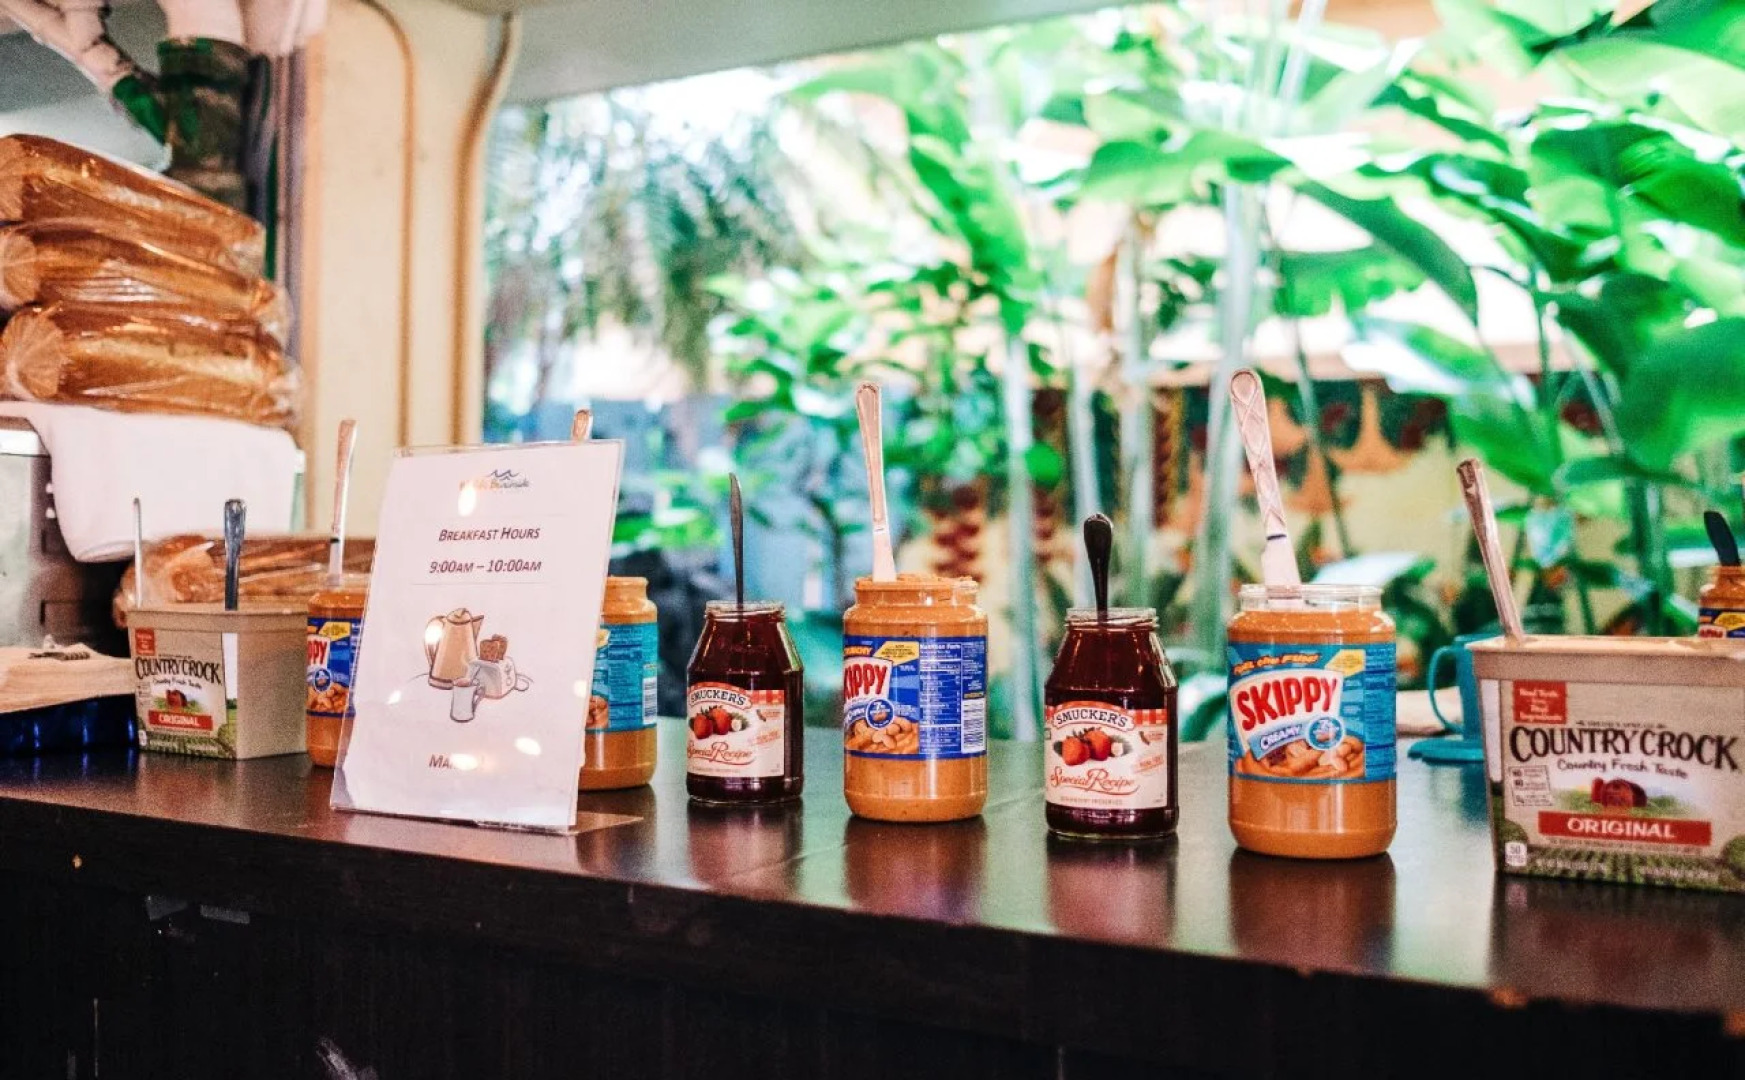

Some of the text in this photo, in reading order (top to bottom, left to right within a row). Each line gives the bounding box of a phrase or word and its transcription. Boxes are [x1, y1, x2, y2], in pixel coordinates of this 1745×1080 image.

[438, 527, 541, 541] BREAKFAST HOURS
[429, 561, 474, 574] 9:00AM
[487, 559, 542, 572] 10:00AM
[307, 640, 328, 665] PPY
[135, 657, 222, 685] COUNTRY CROCK
[844, 663, 888, 700] KIPPY
[691, 689, 747, 706] SMUCKER'S
[1236, 676, 1338, 731] SKIPPY
[159, 714, 200, 726] ORIGINAL
[1056, 708, 1129, 727] SMUCKER'S
[1509, 726, 1739, 773] COUNTRY CROCK
[1050, 766, 1136, 791] Special Recipe
[1557, 757, 1607, 773] Country
[1611, 758, 1648, 772] Fresh
[1653, 763, 1688, 780] Taste
[1566, 816, 1676, 839] ORIGINAL
